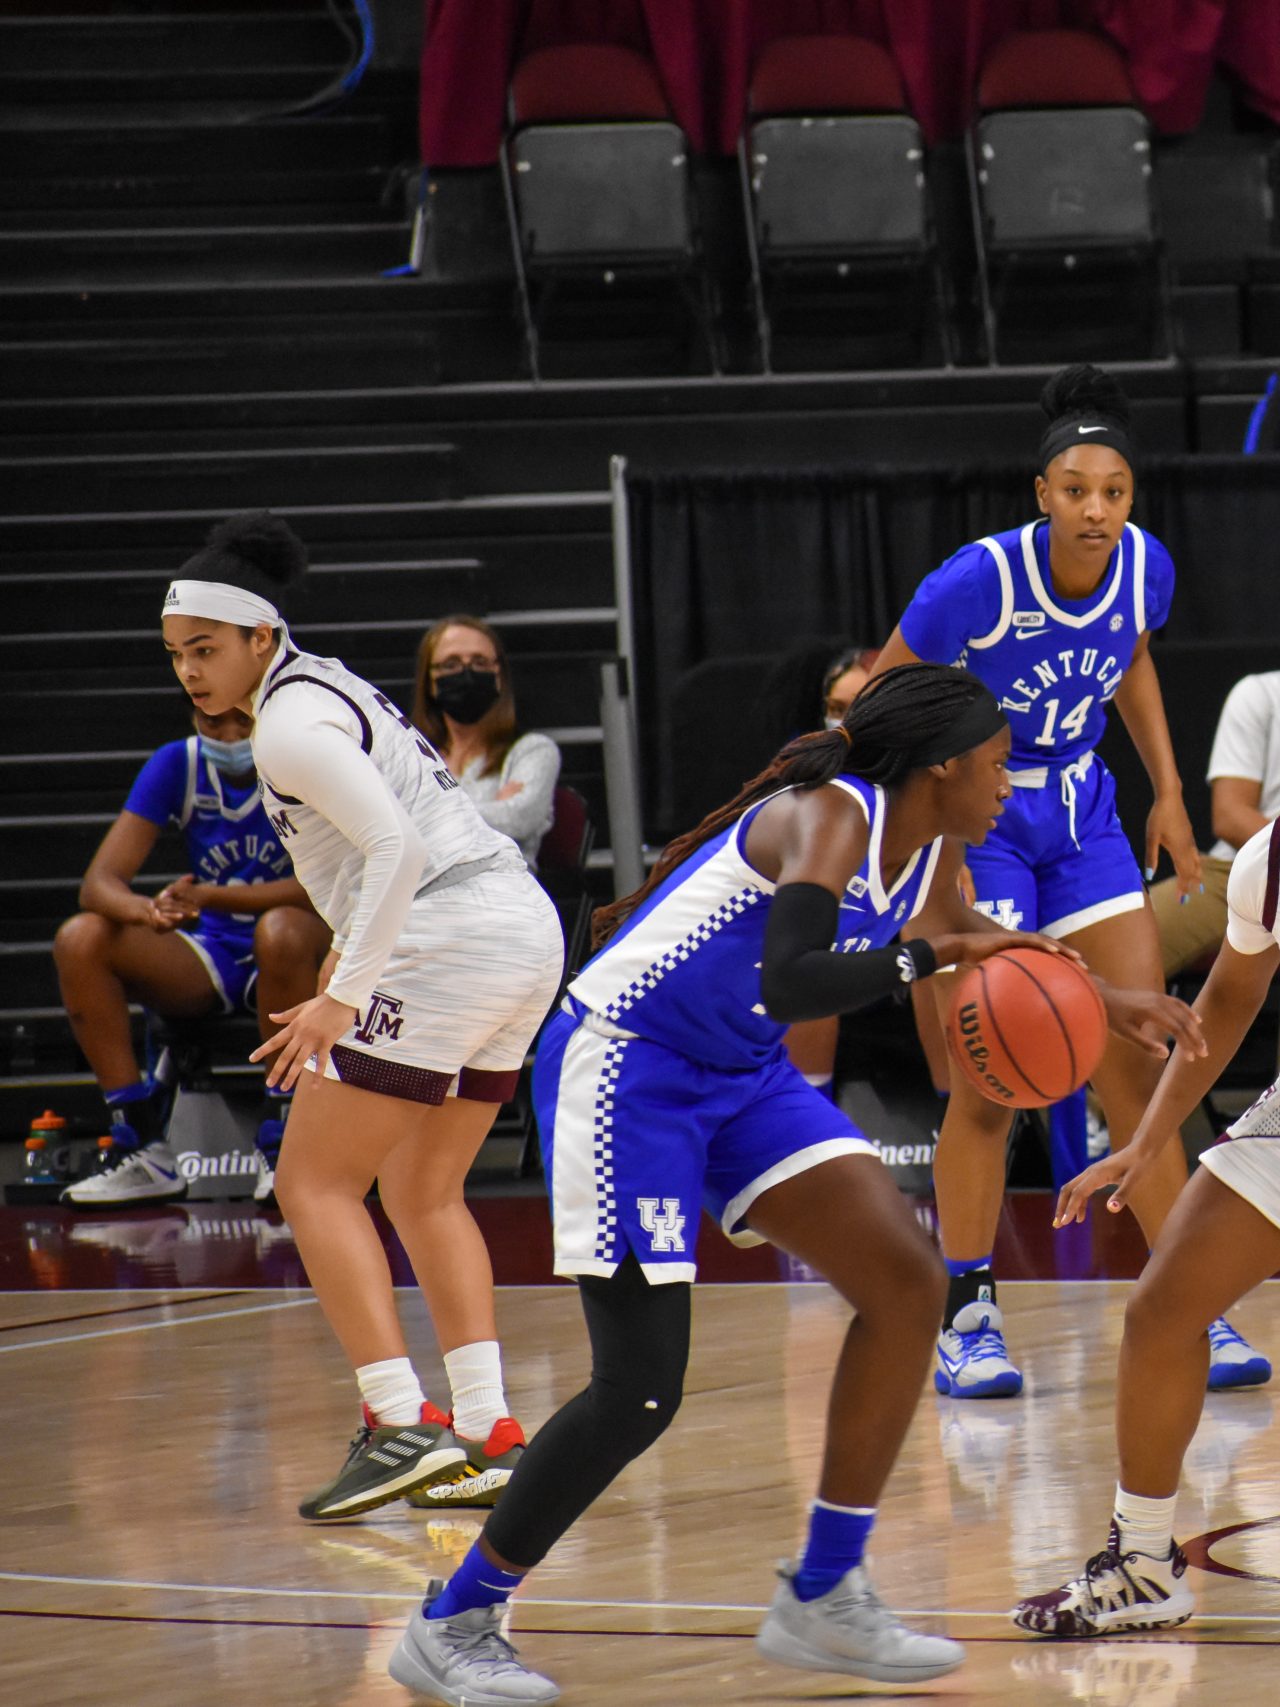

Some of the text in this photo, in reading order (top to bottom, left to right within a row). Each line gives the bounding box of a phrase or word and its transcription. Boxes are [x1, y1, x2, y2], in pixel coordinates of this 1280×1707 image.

[1034, 694, 1095, 747] 14
[959, 1000, 1016, 1099] Wilson
[637, 1197, 686, 1252] UK
